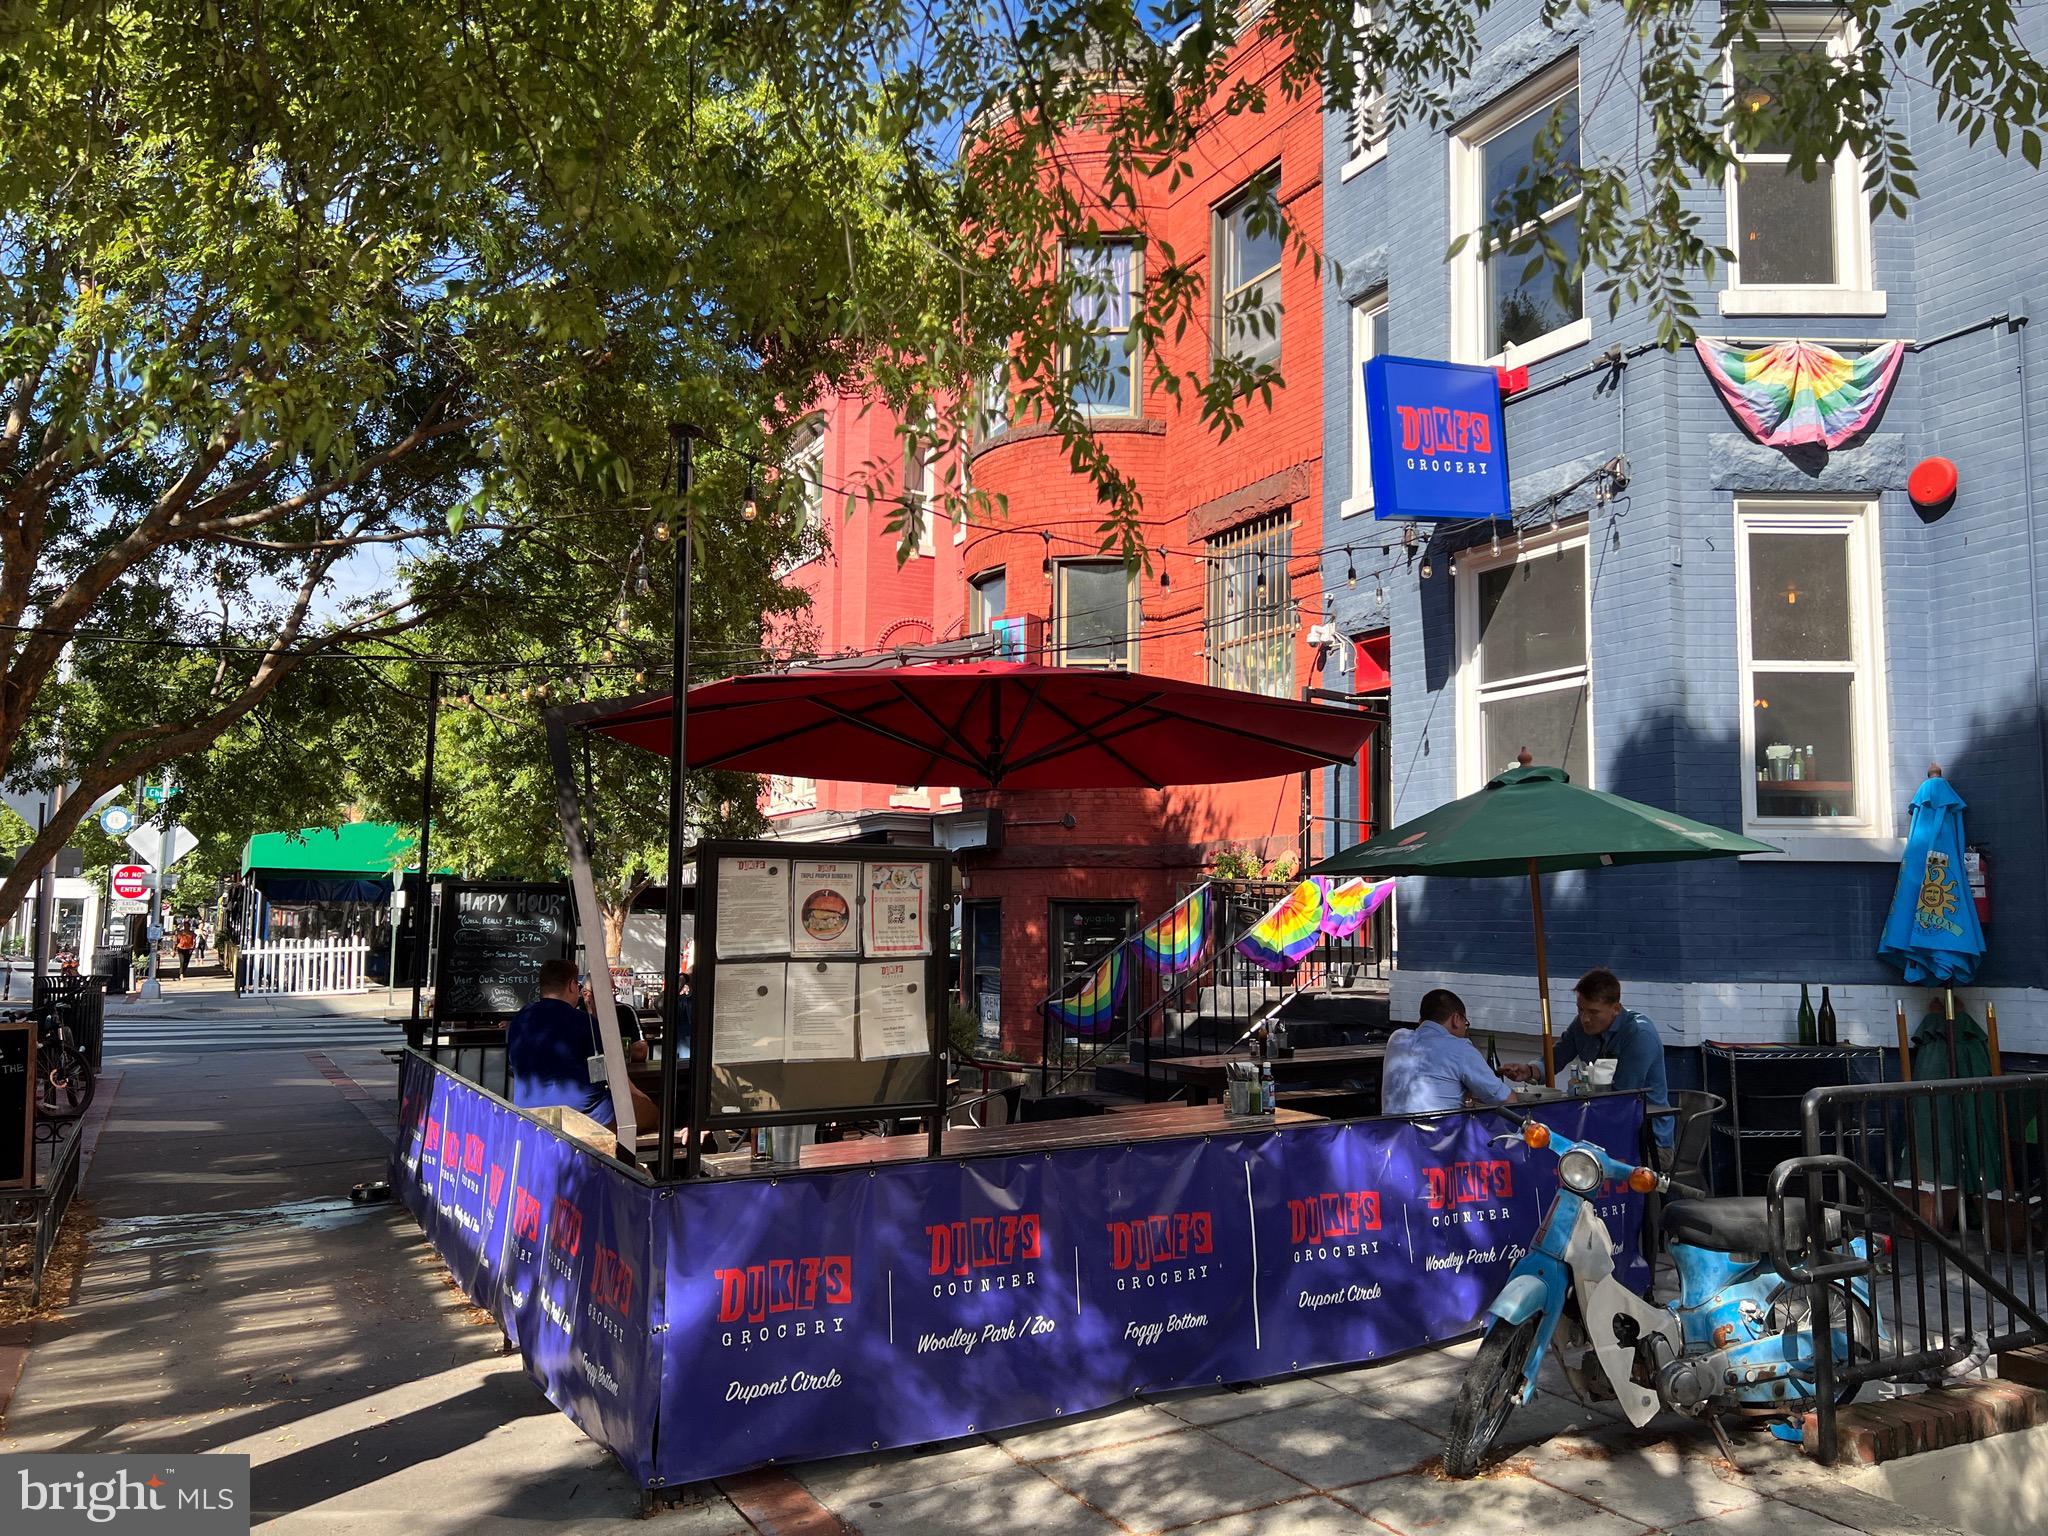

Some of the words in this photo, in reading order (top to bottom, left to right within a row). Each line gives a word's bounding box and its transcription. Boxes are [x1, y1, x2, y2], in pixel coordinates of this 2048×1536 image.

[1396, 406, 1492, 456] DUKE'S
[1407, 458, 1488, 475] GROCERY
[459, 892, 508, 913] HAPPY
[479, 974, 494, 984] OUR
[498, 974, 528, 984] SISTER
[2, 1064, 24, 1073] THE
[1422, 1160, 1513, 1211] DUKE'S
[1288, 1191, 1381, 1245] DUKE'S
[1432, 1208, 1510, 1228] COUNTER
[1593, 1203, 1626, 1218] CERY
[925, 1214, 1041, 1277] DUKE'S
[1107, 1211, 1213, 1272] DUKE'S
[1293, 1241, 1379, 1263] GROCERY
[1425, 1254, 1464, 1274] Woodley
[1466, 1250, 1496, 1267] Park
[1509, 1244, 1526, 1259] Zoo
[714, 1255, 852, 1324] DUKE'S
[933, 1271, 1037, 1298] COUNTER
[1116, 1264, 1209, 1292] GROCERY
[1298, 1290, 1345, 1310] Dupont
[1347, 1283, 1382, 1302] Circle
[587, 1303, 624, 1343] GROCERY
[722, 1317, 845, 1347] GROCERY
[917, 1331, 978, 1356] Woodley
[981, 1324, 1017, 1345] Park
[1031, 1316, 1055, 1336] Zoo
[1124, 1320, 1163, 1347] Foggy
[1165, 1314, 1209, 1333] Bottom
[582, 1352, 598, 1388] Foggy
[598, 1365, 619, 1396] Bottom
[725, 1378, 787, 1404] Dupont
[790, 1369, 842, 1393] Circle
